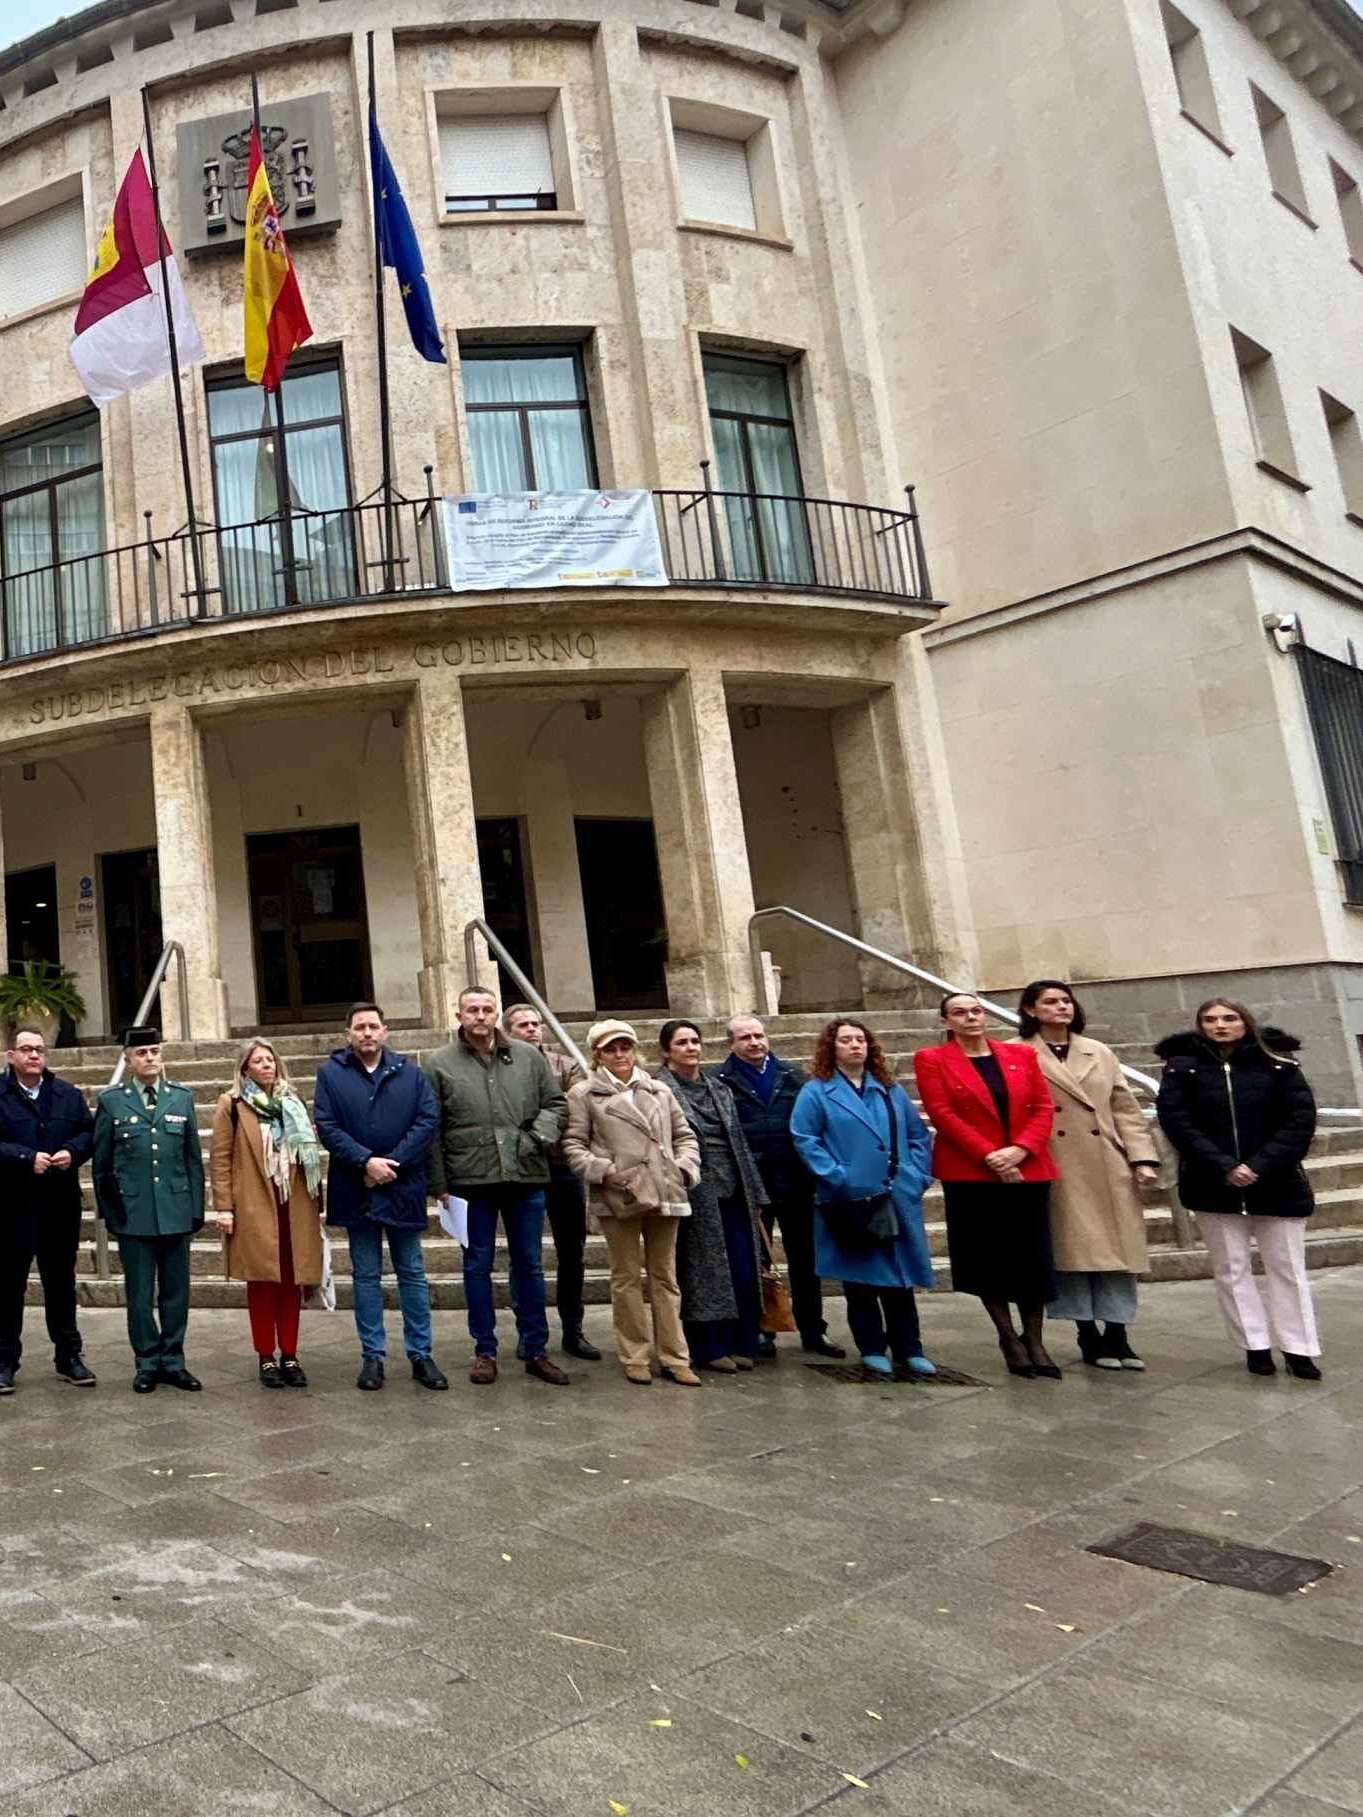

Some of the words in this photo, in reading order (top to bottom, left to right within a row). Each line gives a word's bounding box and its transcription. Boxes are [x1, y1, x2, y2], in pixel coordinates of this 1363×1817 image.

[29, 657, 311, 724] SUBDELEGACION
[324, 646, 394, 678] DEL
[413, 632, 596, 668] GOBIERNO
